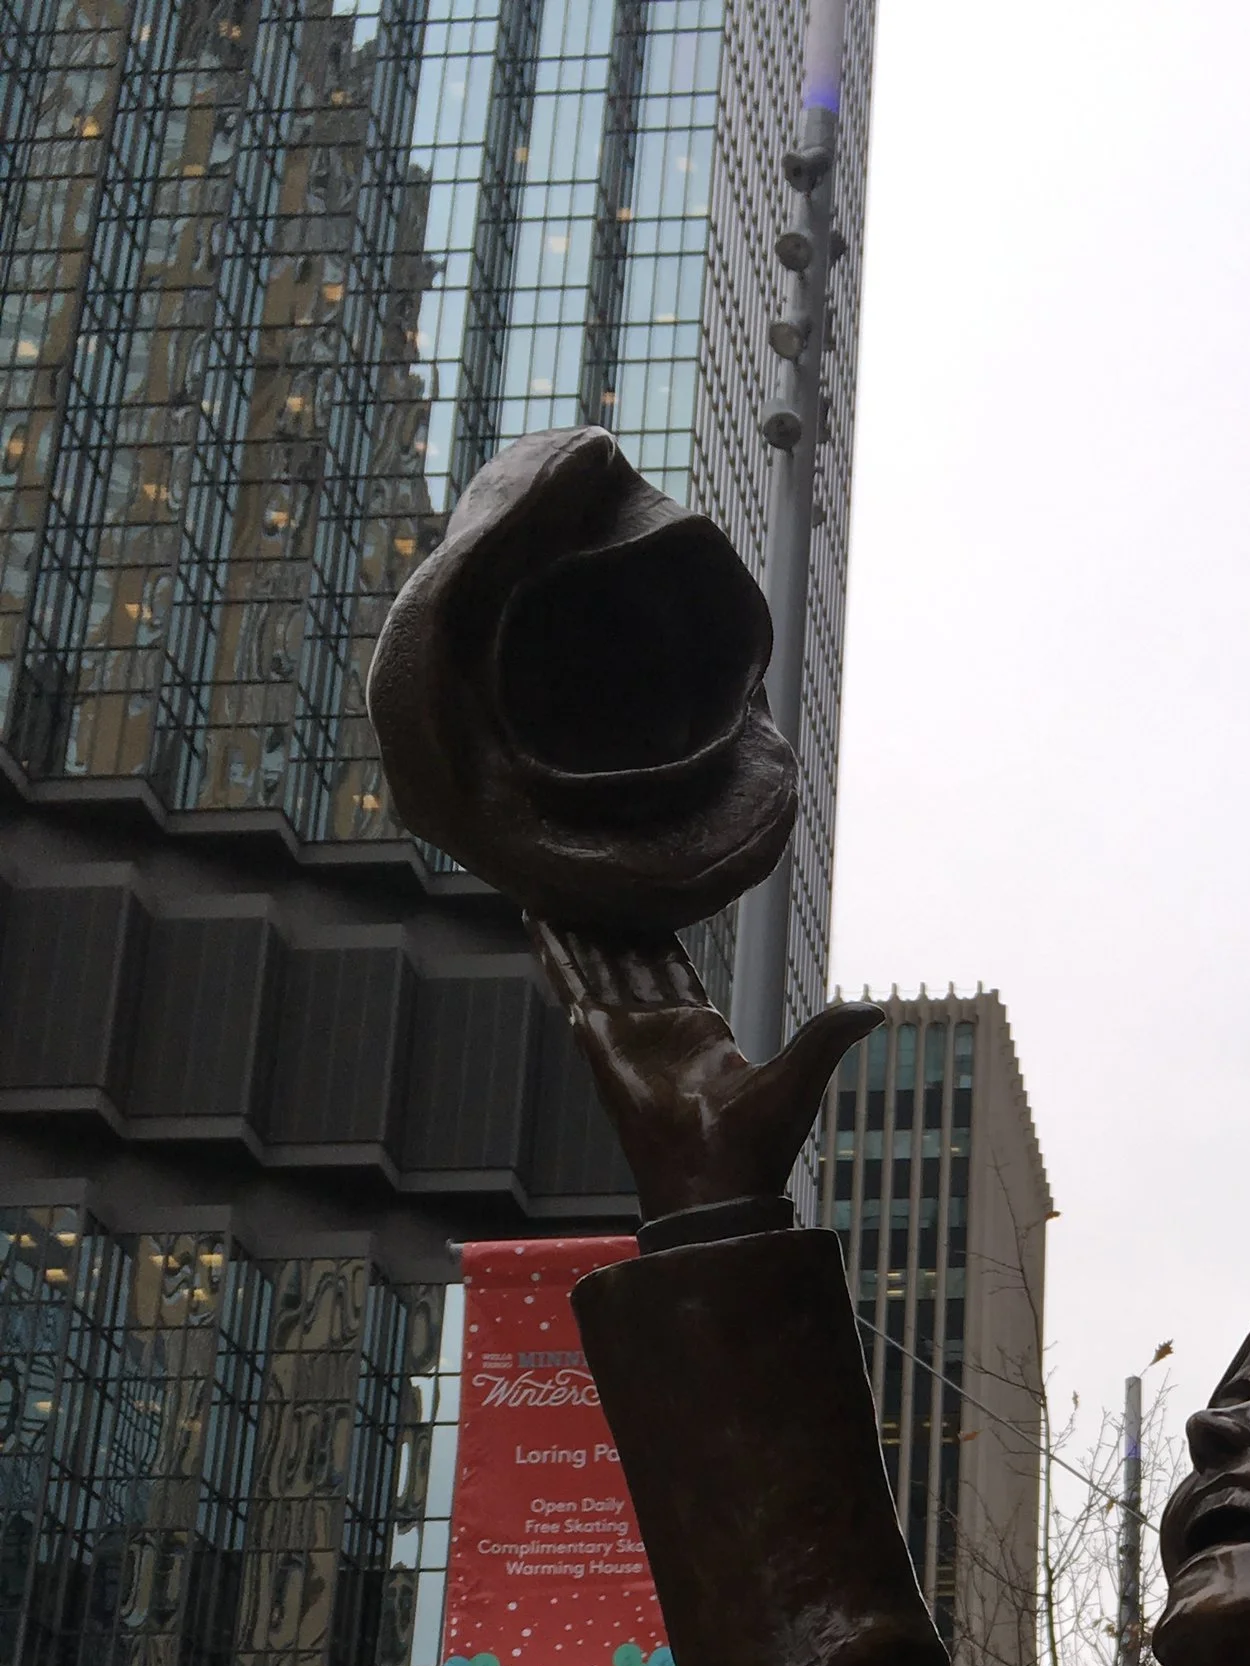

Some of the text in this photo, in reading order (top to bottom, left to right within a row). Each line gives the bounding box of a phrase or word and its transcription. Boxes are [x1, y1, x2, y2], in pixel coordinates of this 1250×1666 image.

[516, 1445, 586, 1468] Loring
[531, 1497, 625, 1516] Open Daily
[525, 1519, 629, 1536] Free Skating
[477, 1539, 613, 1558] Complimentary
[506, 1560, 643, 1579] Warming House
